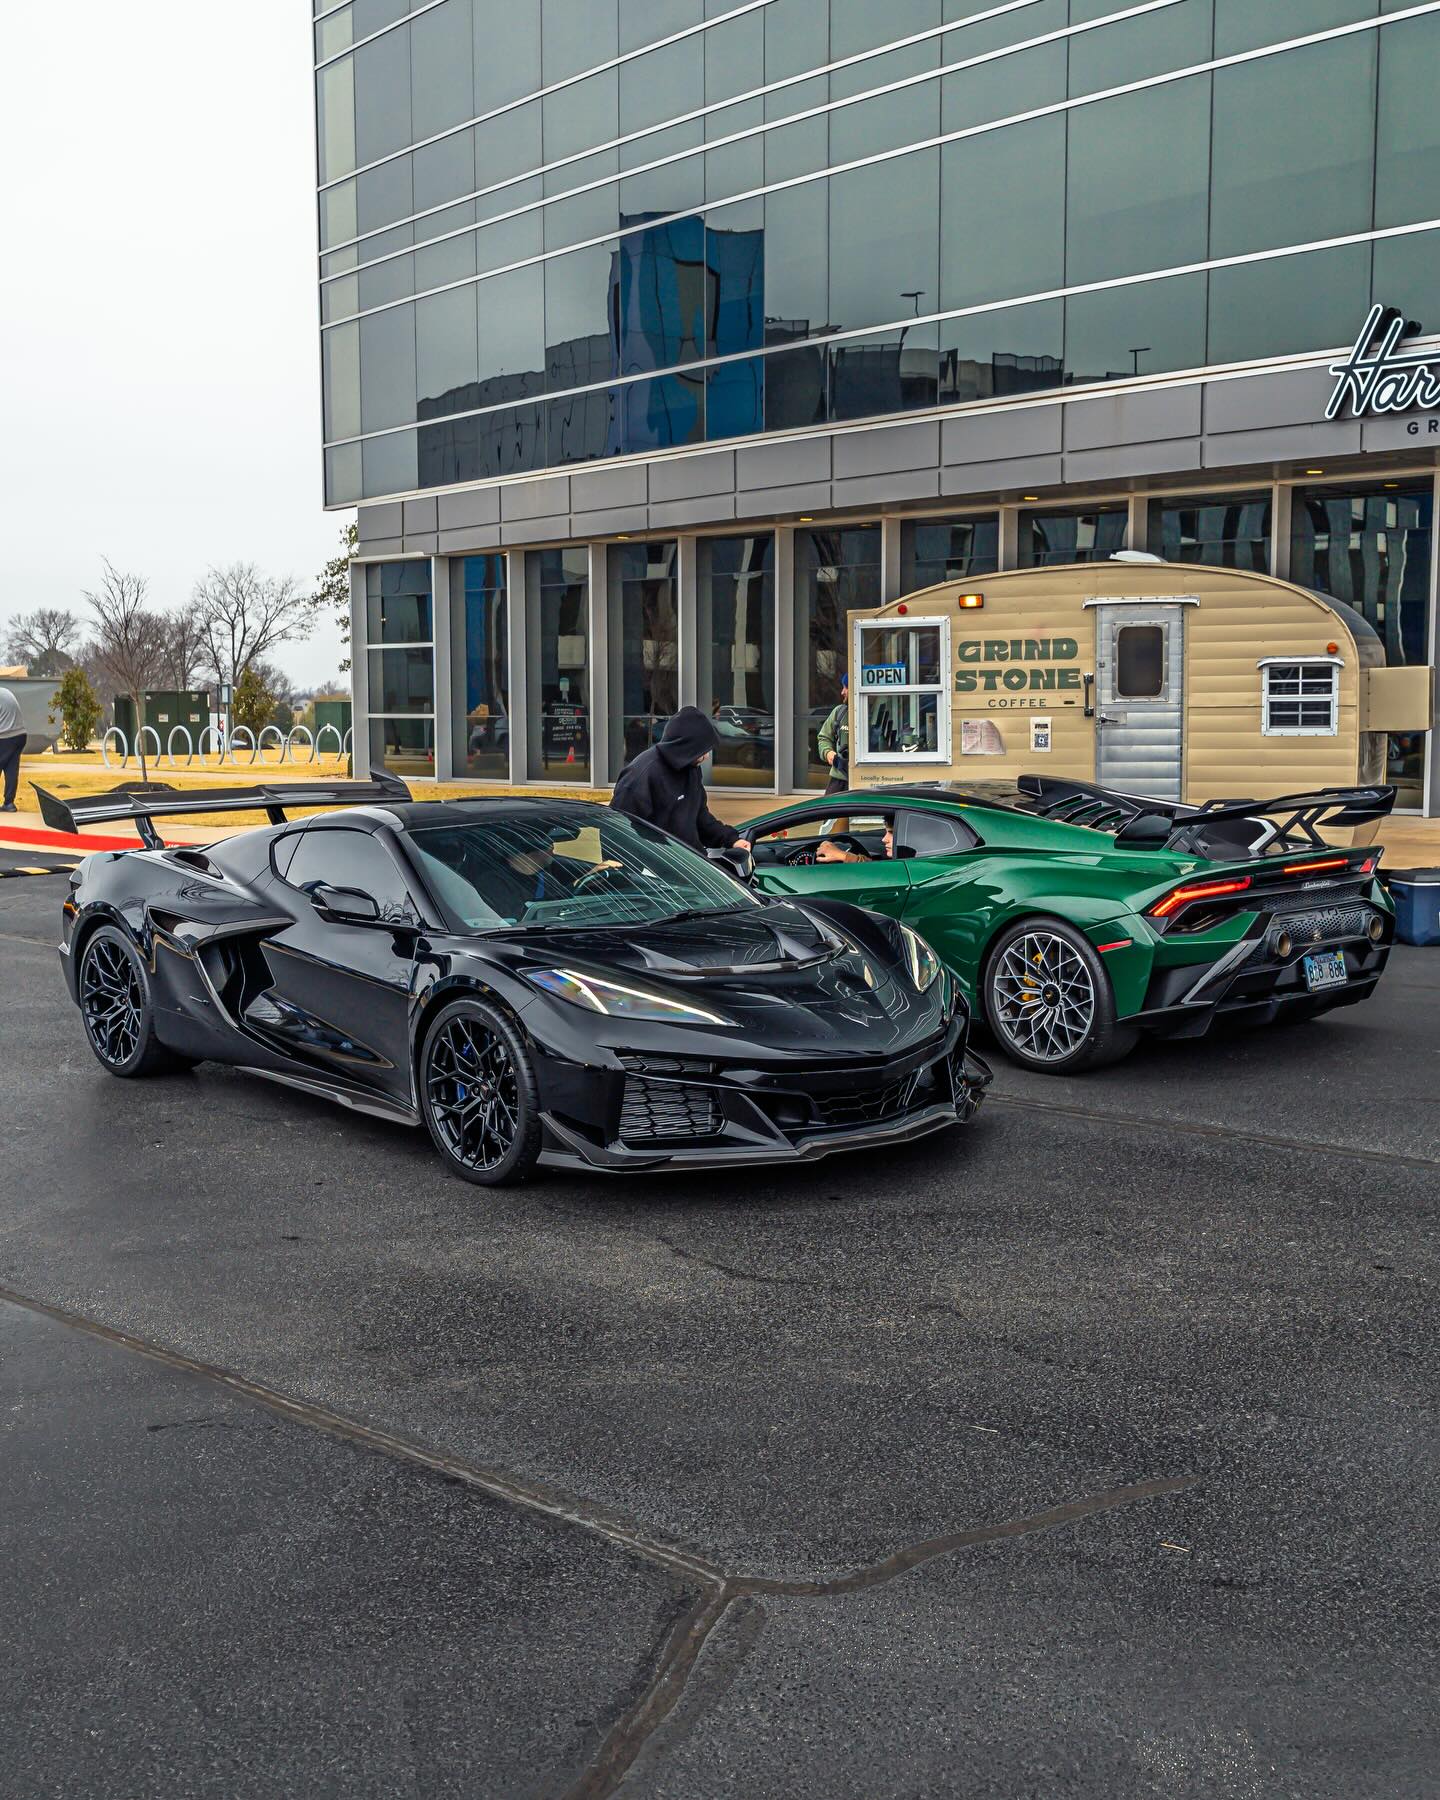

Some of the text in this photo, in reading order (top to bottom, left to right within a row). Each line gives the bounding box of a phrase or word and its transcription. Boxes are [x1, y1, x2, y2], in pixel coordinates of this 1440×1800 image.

[1407, 420, 1439, 435] GR
[957, 637, 1079, 663] GRIND
[866, 668, 903, 684] OPEN
[955, 668, 1082, 692] STONE
[987, 698, 1047, 708] COFFEE
